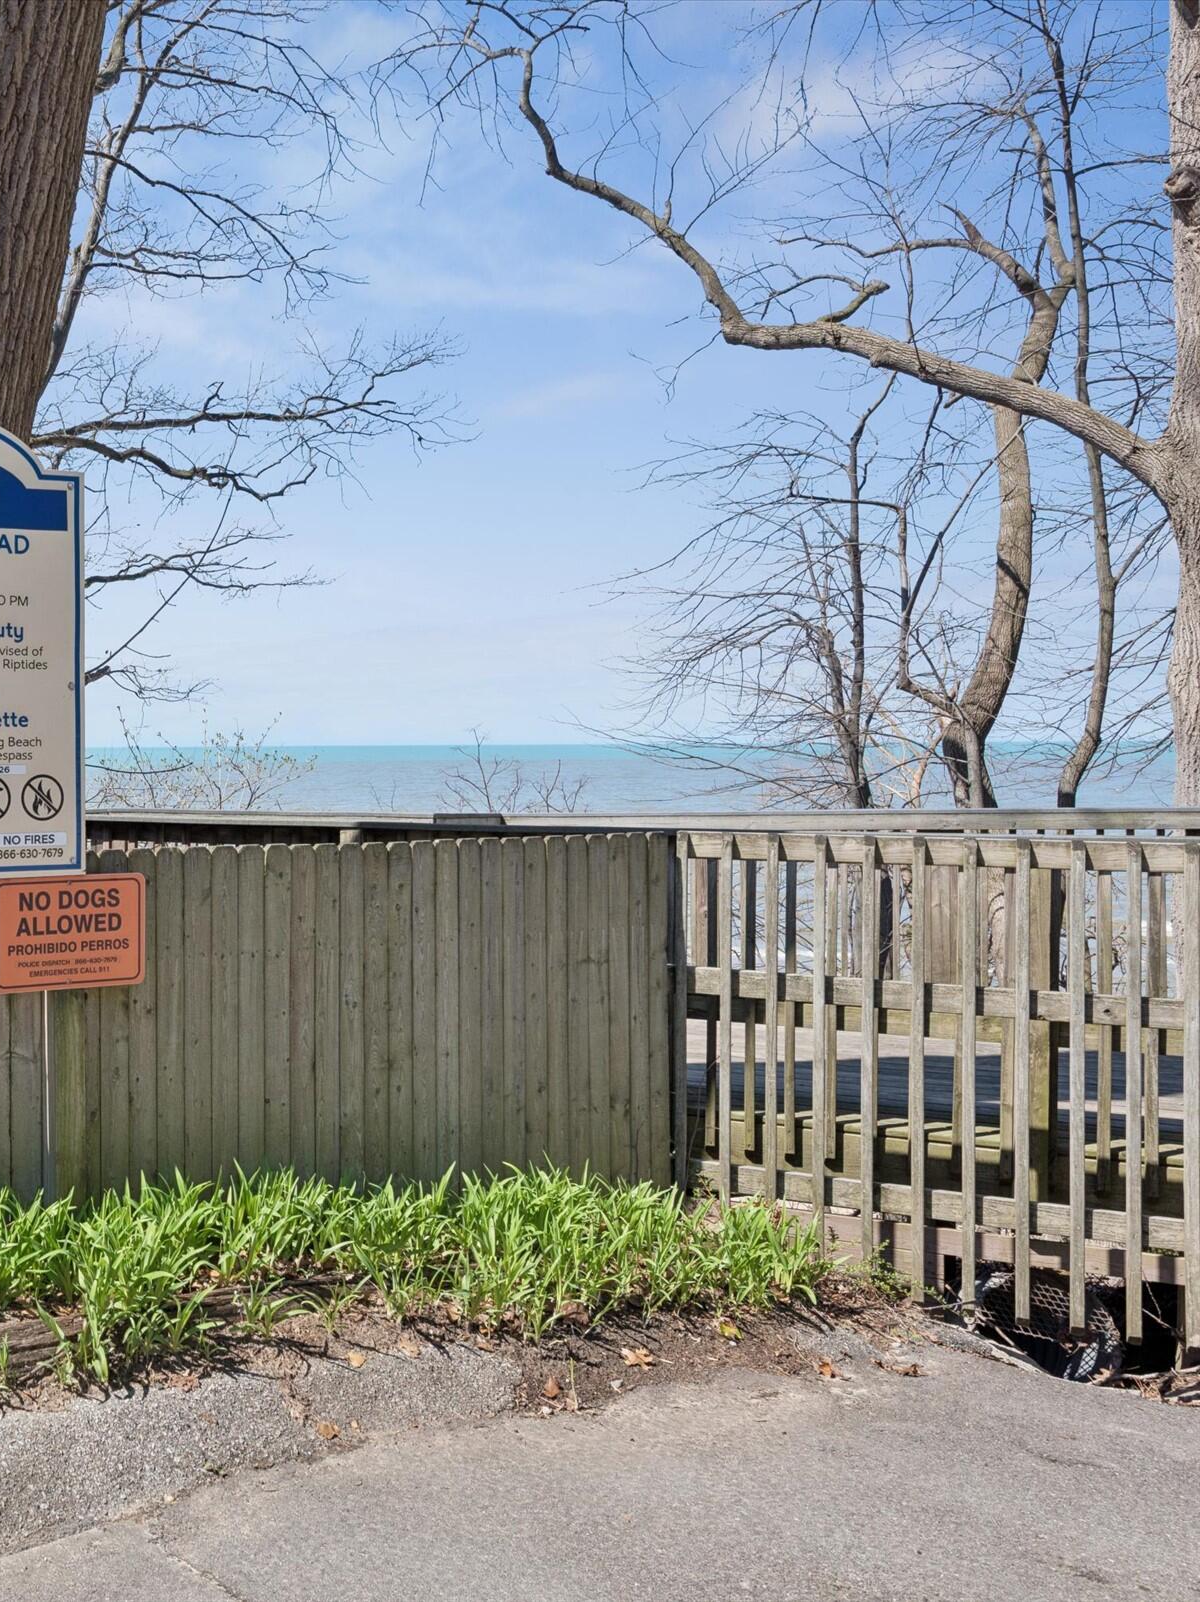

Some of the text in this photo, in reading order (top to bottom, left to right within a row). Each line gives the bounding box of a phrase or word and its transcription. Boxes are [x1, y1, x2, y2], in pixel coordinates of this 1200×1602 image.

[10, 595, 29, 606] PM
[32, 646, 43, 656] of
[2, 659, 48, 672] Riptides
[8, 736, 42, 747] Beach
[3, 835, 21, 845] NO
[24, 834, 55, 845] FIRES
[19, 888, 120, 911] NO DOGS
[16, 913, 122, 936] ALLOWED
[8, 938, 129, 956] PROHIBIDO PERROS
[29, 968, 78, 977] EMERGENCIES
